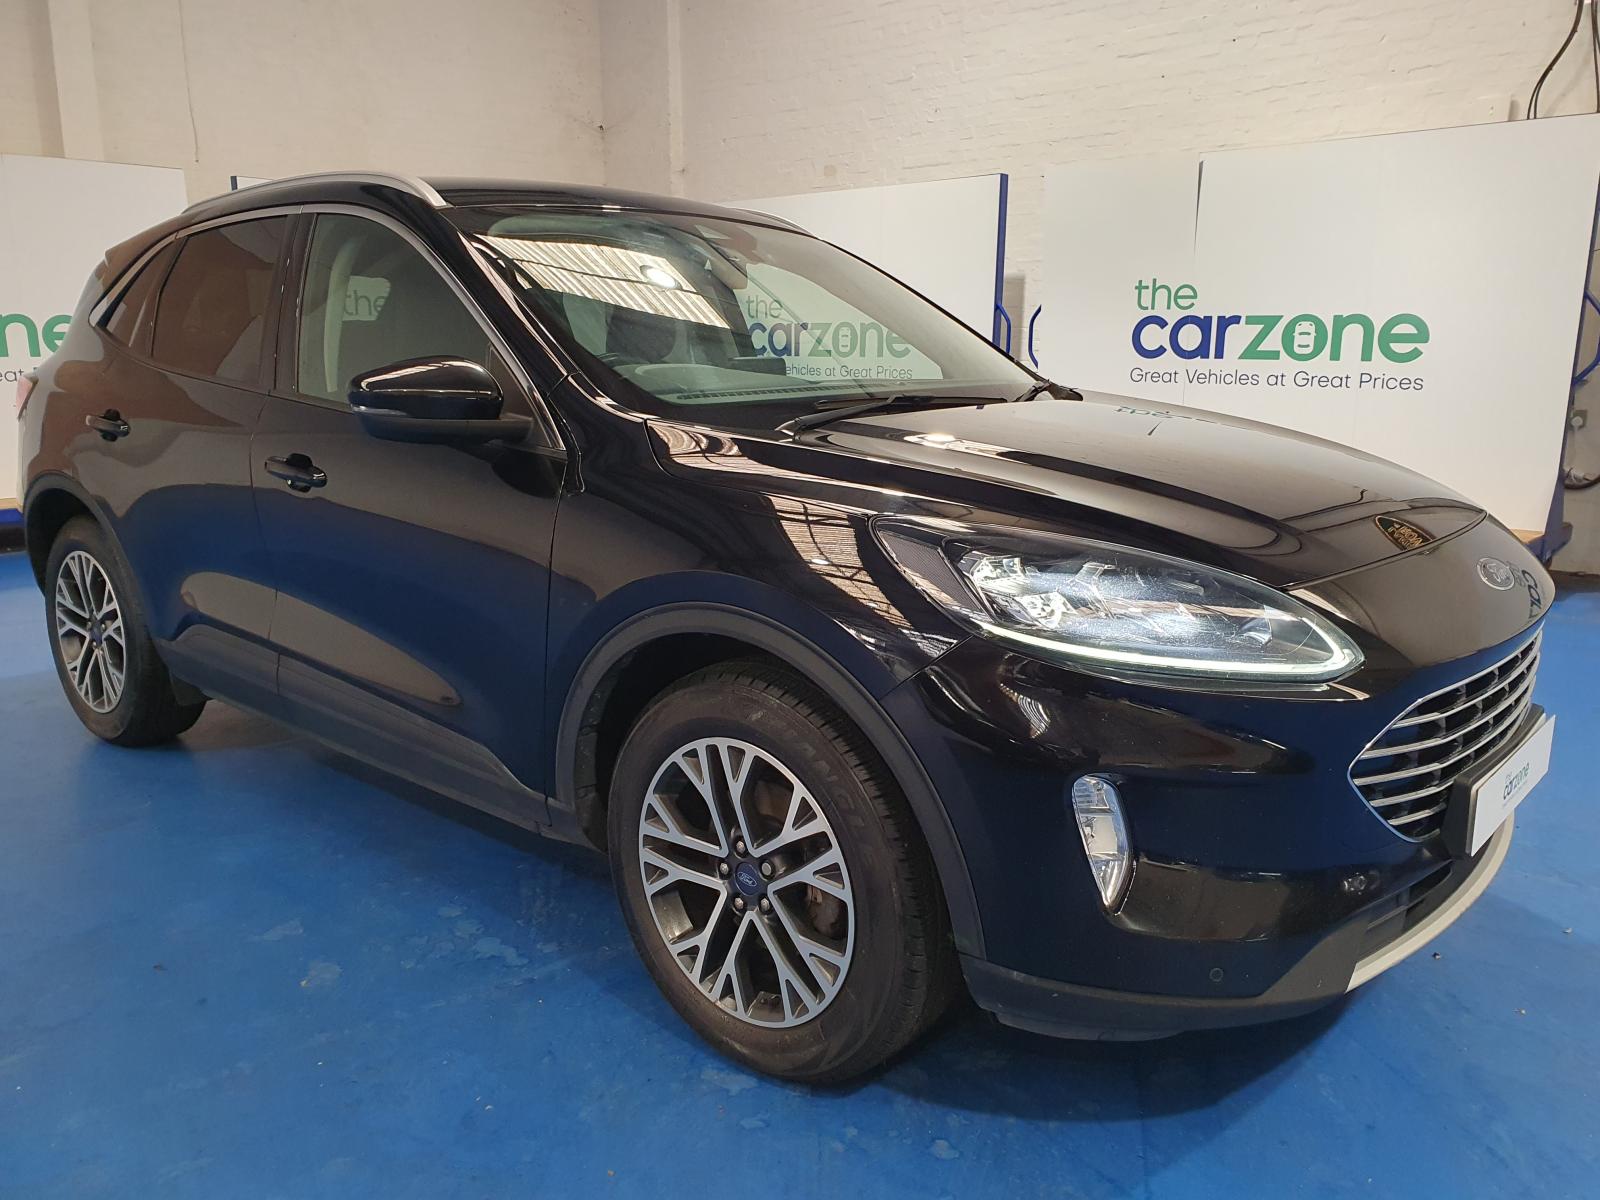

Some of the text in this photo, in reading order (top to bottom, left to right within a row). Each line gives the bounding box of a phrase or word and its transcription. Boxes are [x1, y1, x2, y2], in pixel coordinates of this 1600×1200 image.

[344, 290, 386, 316] the
[746, 295, 782, 319] the
[1135, 278, 1198, 311] the
[749, 321, 912, 359] carzone
[1131, 313, 1430, 363] carzone
[785, 364, 913, 380] ehicles at Great Prices
[1130, 367, 1425, 391] Great Vehicles at Great Prices
